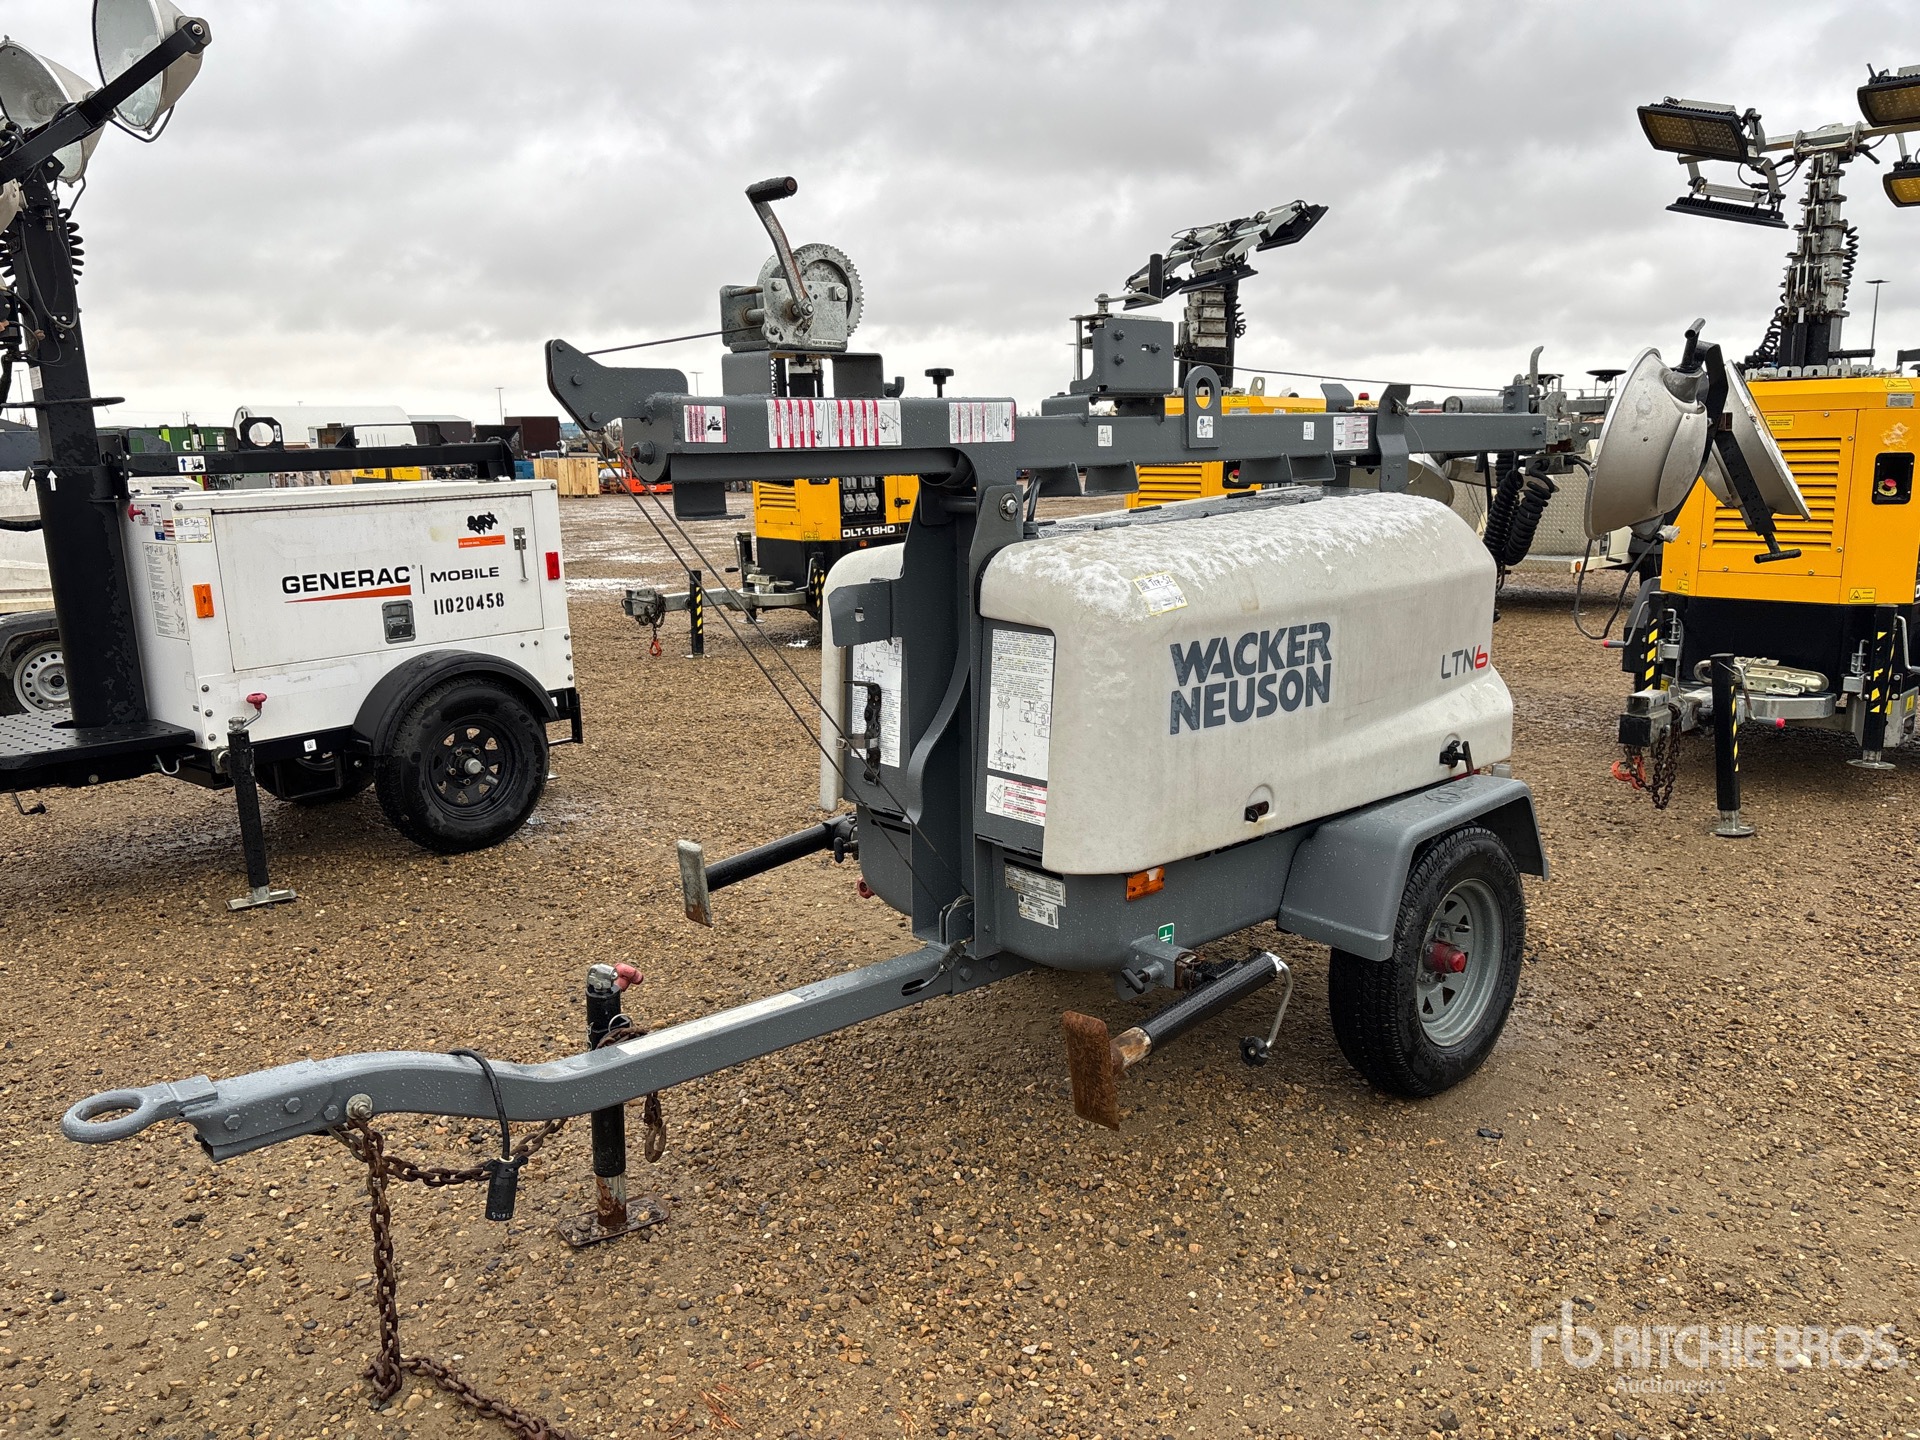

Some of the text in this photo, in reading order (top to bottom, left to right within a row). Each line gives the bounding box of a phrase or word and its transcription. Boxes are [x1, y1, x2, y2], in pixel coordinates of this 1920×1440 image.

[842, 525, 896, 538] DLT-18HD
[281, 565, 500, 595] GENERAC MOBILE
[433, 592, 505, 616] 11020458
[1169, 621, 1333, 687] WACKER
[1441, 644, 1489, 680] LTN6
[1169, 662, 1332, 736] NEUSON
